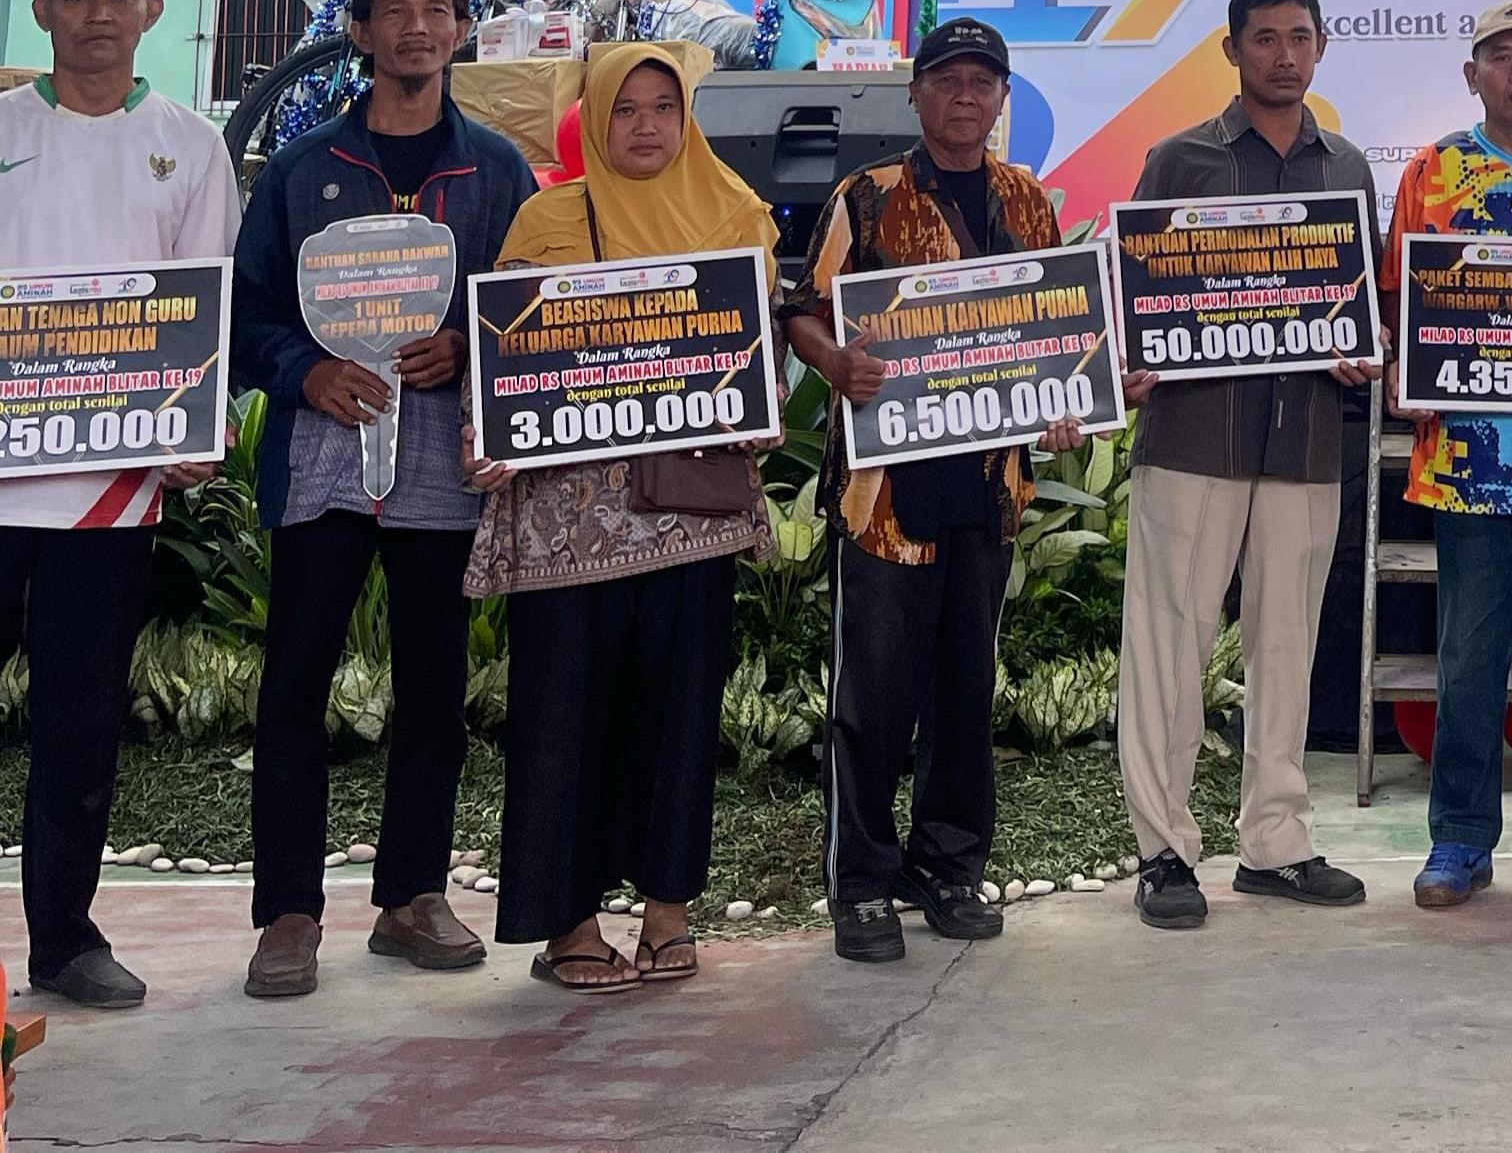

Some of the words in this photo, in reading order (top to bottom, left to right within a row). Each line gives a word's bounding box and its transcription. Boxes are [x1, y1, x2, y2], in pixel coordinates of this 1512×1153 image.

[1318, 7, 1448, 37] xcellent
[1125, 230, 1190, 255] BANTUAN
[1191, 226, 1281, 252] PERMODALAN
[1282, 223, 1354, 246] PRODUKTIF
[1148, 255, 1195, 278] UNTUK
[1196, 250, 1272, 275] KARYAWAN
[1273, 249, 1303, 271] ALIH
[1305, 247, 1339, 269] DAYA
[1202, 277, 1241, 290] Dalam
[1243, 274, 1286, 289] Rangka
[1418, 269, 1462, 287] PAKET
[28, 302, 99, 329] TENAGA
[102, 299, 142, 326] NON
[145, 297, 197, 323] GURU
[354, 301, 362, 318] 1
[365, 299, 402, 318] UNIT
[541, 296, 629, 327] BEASISWA
[634, 289, 699, 315] KEPADA
[859, 305, 945, 342] SANTUNAN
[946, 293, 1033, 332] KARYAWAN
[1035, 286, 1090, 320] PURNA
[1134, 296, 1171, 314] MILAD
[1173, 295, 1190, 312] RS
[1192, 292, 1229, 310] UMUM
[1231, 289, 1280, 308] AMINAH
[1282, 286, 1323, 305] BLITAR
[1325, 285, 1341, 302] KE
[1342, 284, 1358, 302] 19
[380, 314, 436, 335] MOTOR
[498, 326, 586, 357] KELUARGA
[590, 318, 683, 347] KARYAWAN
[686, 310, 743, 338] PURNA
[934, 336, 974, 350] Dalam
[976, 329, 1021, 346] Rangka
[1419, 327, 1456, 345] MILAD
[1457, 327, 1474, 345] RS
[1476, 328, 1512, 346] UMUM
[44, 327, 157, 357] PENDIDIKAN
[576, 350, 619, 365] Dalam
[622, 344, 670, 361] Rangka
[902, 357, 920, 376] RS
[922, 351, 962, 373] UMUM
[963, 344, 1015, 367] AMINAH
[1017, 338, 1061, 360] BLITAR
[1062, 336, 1079, 354] KE
[1080, 333, 1097, 352] 19
[1141, 316, 1358, 364] 50.000.000
[9, 360, 59, 376] Dalam
[62, 357, 117, 374] Rangka
[494, 374, 538, 396] MILAD
[540, 371, 559, 391] RS
[562, 367, 604, 388] UMUM
[606, 360, 664, 385] AMINAH
[666, 356, 713, 377] BLITAR
[715, 354, 732, 371] KE
[734, 351, 752, 371] 19
[42, 376, 106, 397] AMINAH
[108, 372, 160, 392] BLITAR
[163, 369, 182, 385] KE
[186, 368, 205, 387] 19
[510, 387, 745, 449] 3.000.000
[877, 373, 1095, 446] 6.500.000
